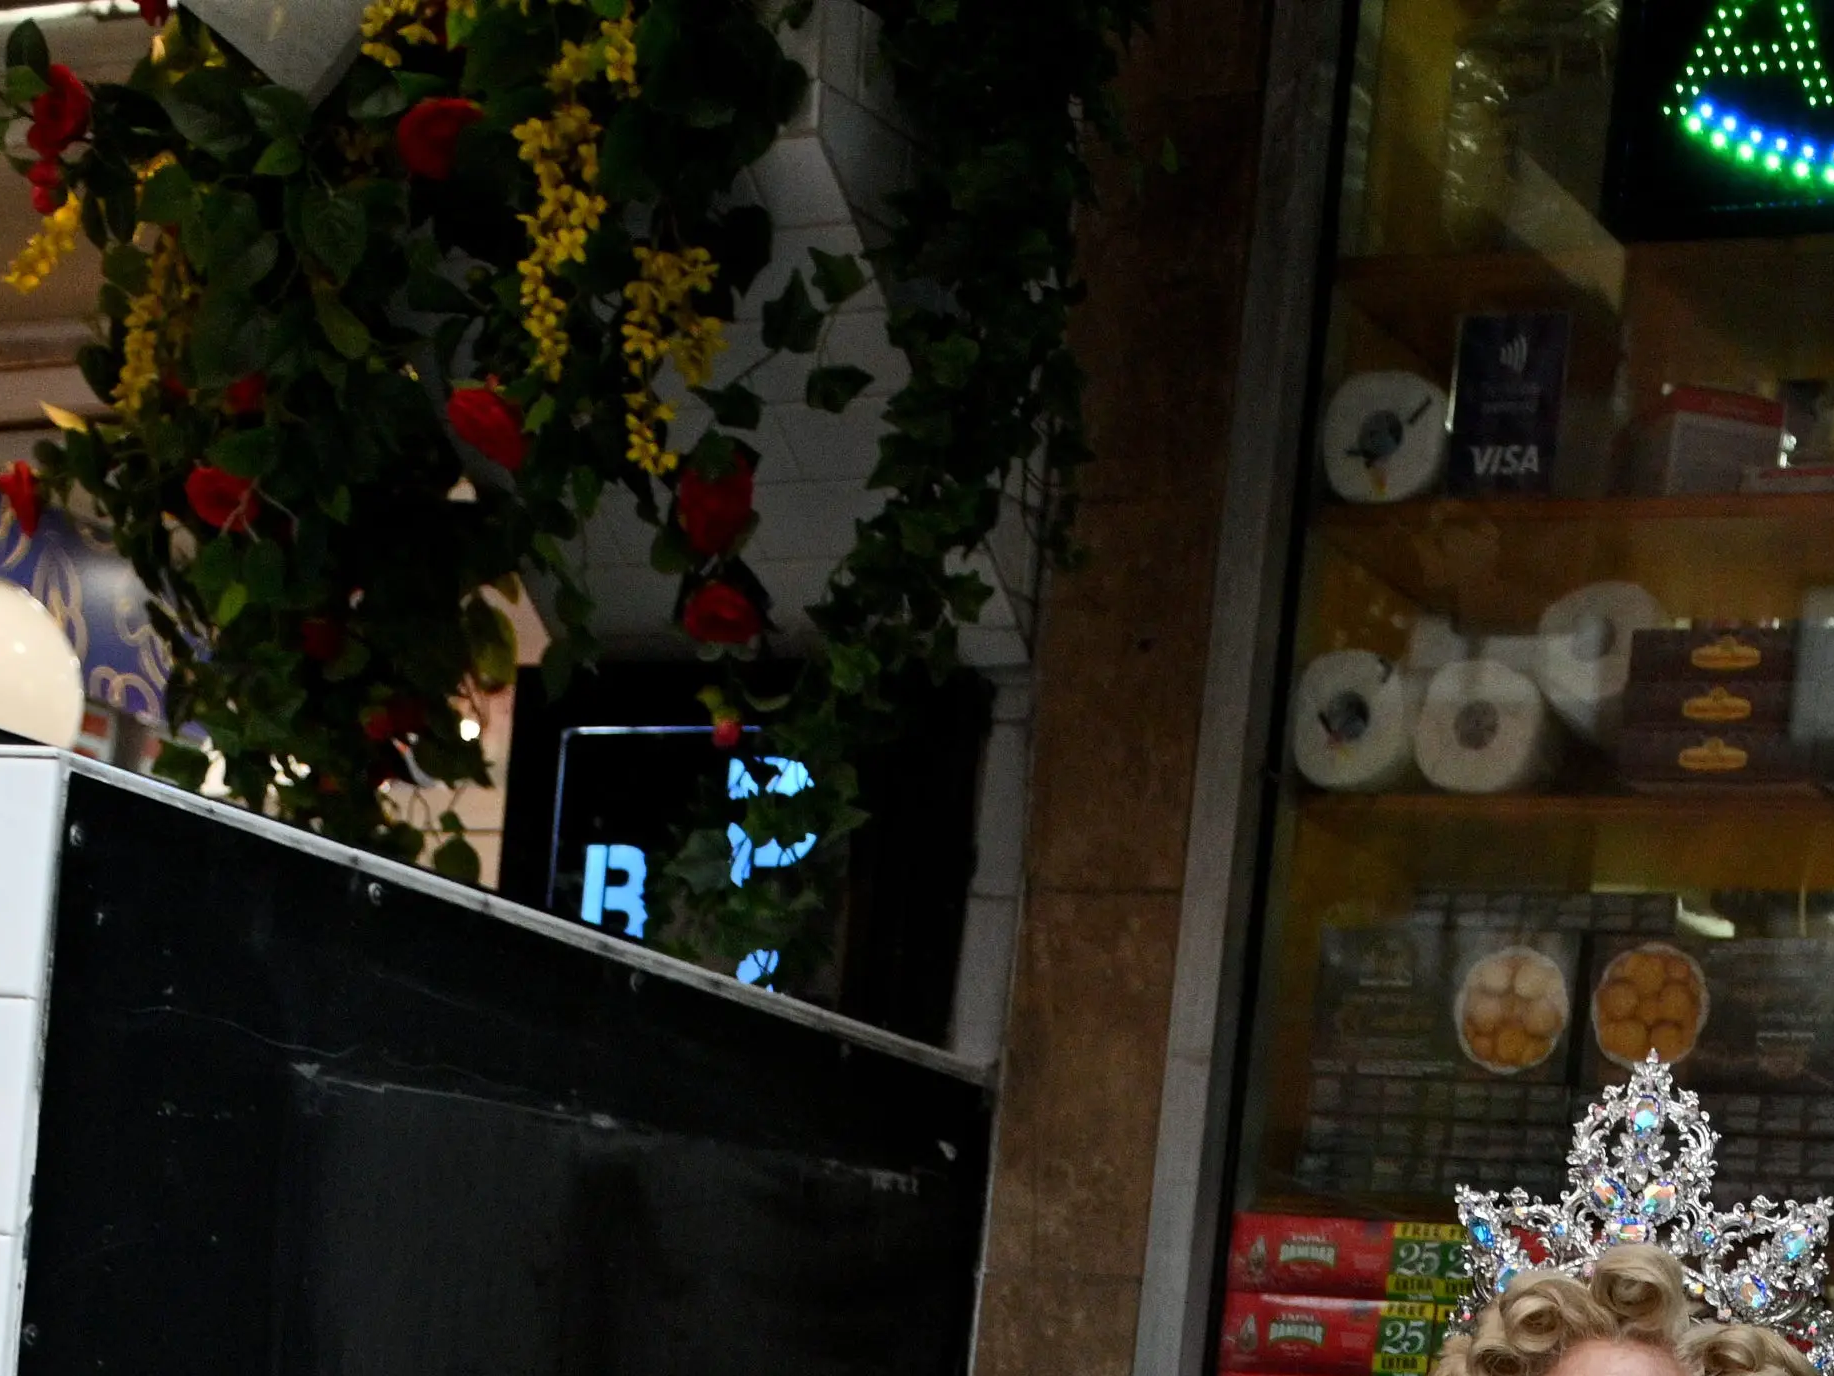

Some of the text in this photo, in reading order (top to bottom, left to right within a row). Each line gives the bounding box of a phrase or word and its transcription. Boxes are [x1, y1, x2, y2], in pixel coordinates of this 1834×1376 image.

[1469, 444, 1539, 476] VISA
[1402, 1223, 1440, 1237] FREE
[1395, 1242, 1441, 1277] 25
[1387, 1303, 1426, 1316] FREE
[1381, 1320, 1427, 1355] 25
